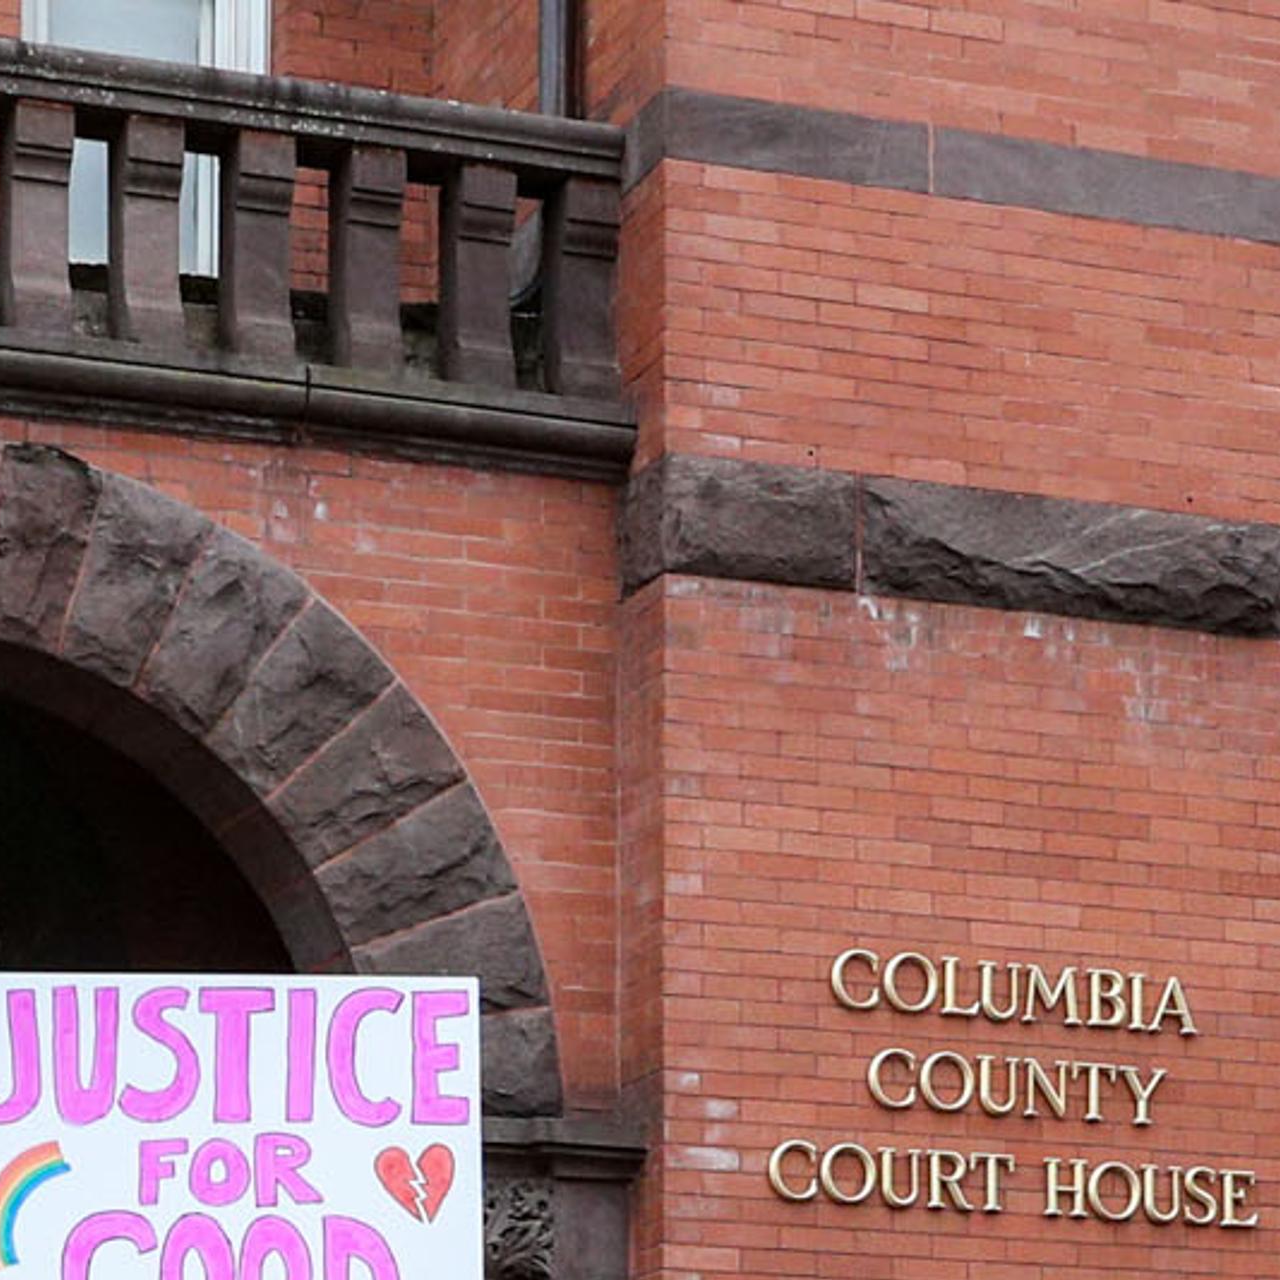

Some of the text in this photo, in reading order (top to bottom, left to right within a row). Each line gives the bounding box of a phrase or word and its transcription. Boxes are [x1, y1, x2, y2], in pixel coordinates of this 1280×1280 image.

[831, 948, 1197, 1035] COLUMBIA
[868, 1047, 1168, 1126] COUNTY
[138, 1132, 324, 1208] FOR
[768, 1138, 1258, 1229] COURT HOUSE
